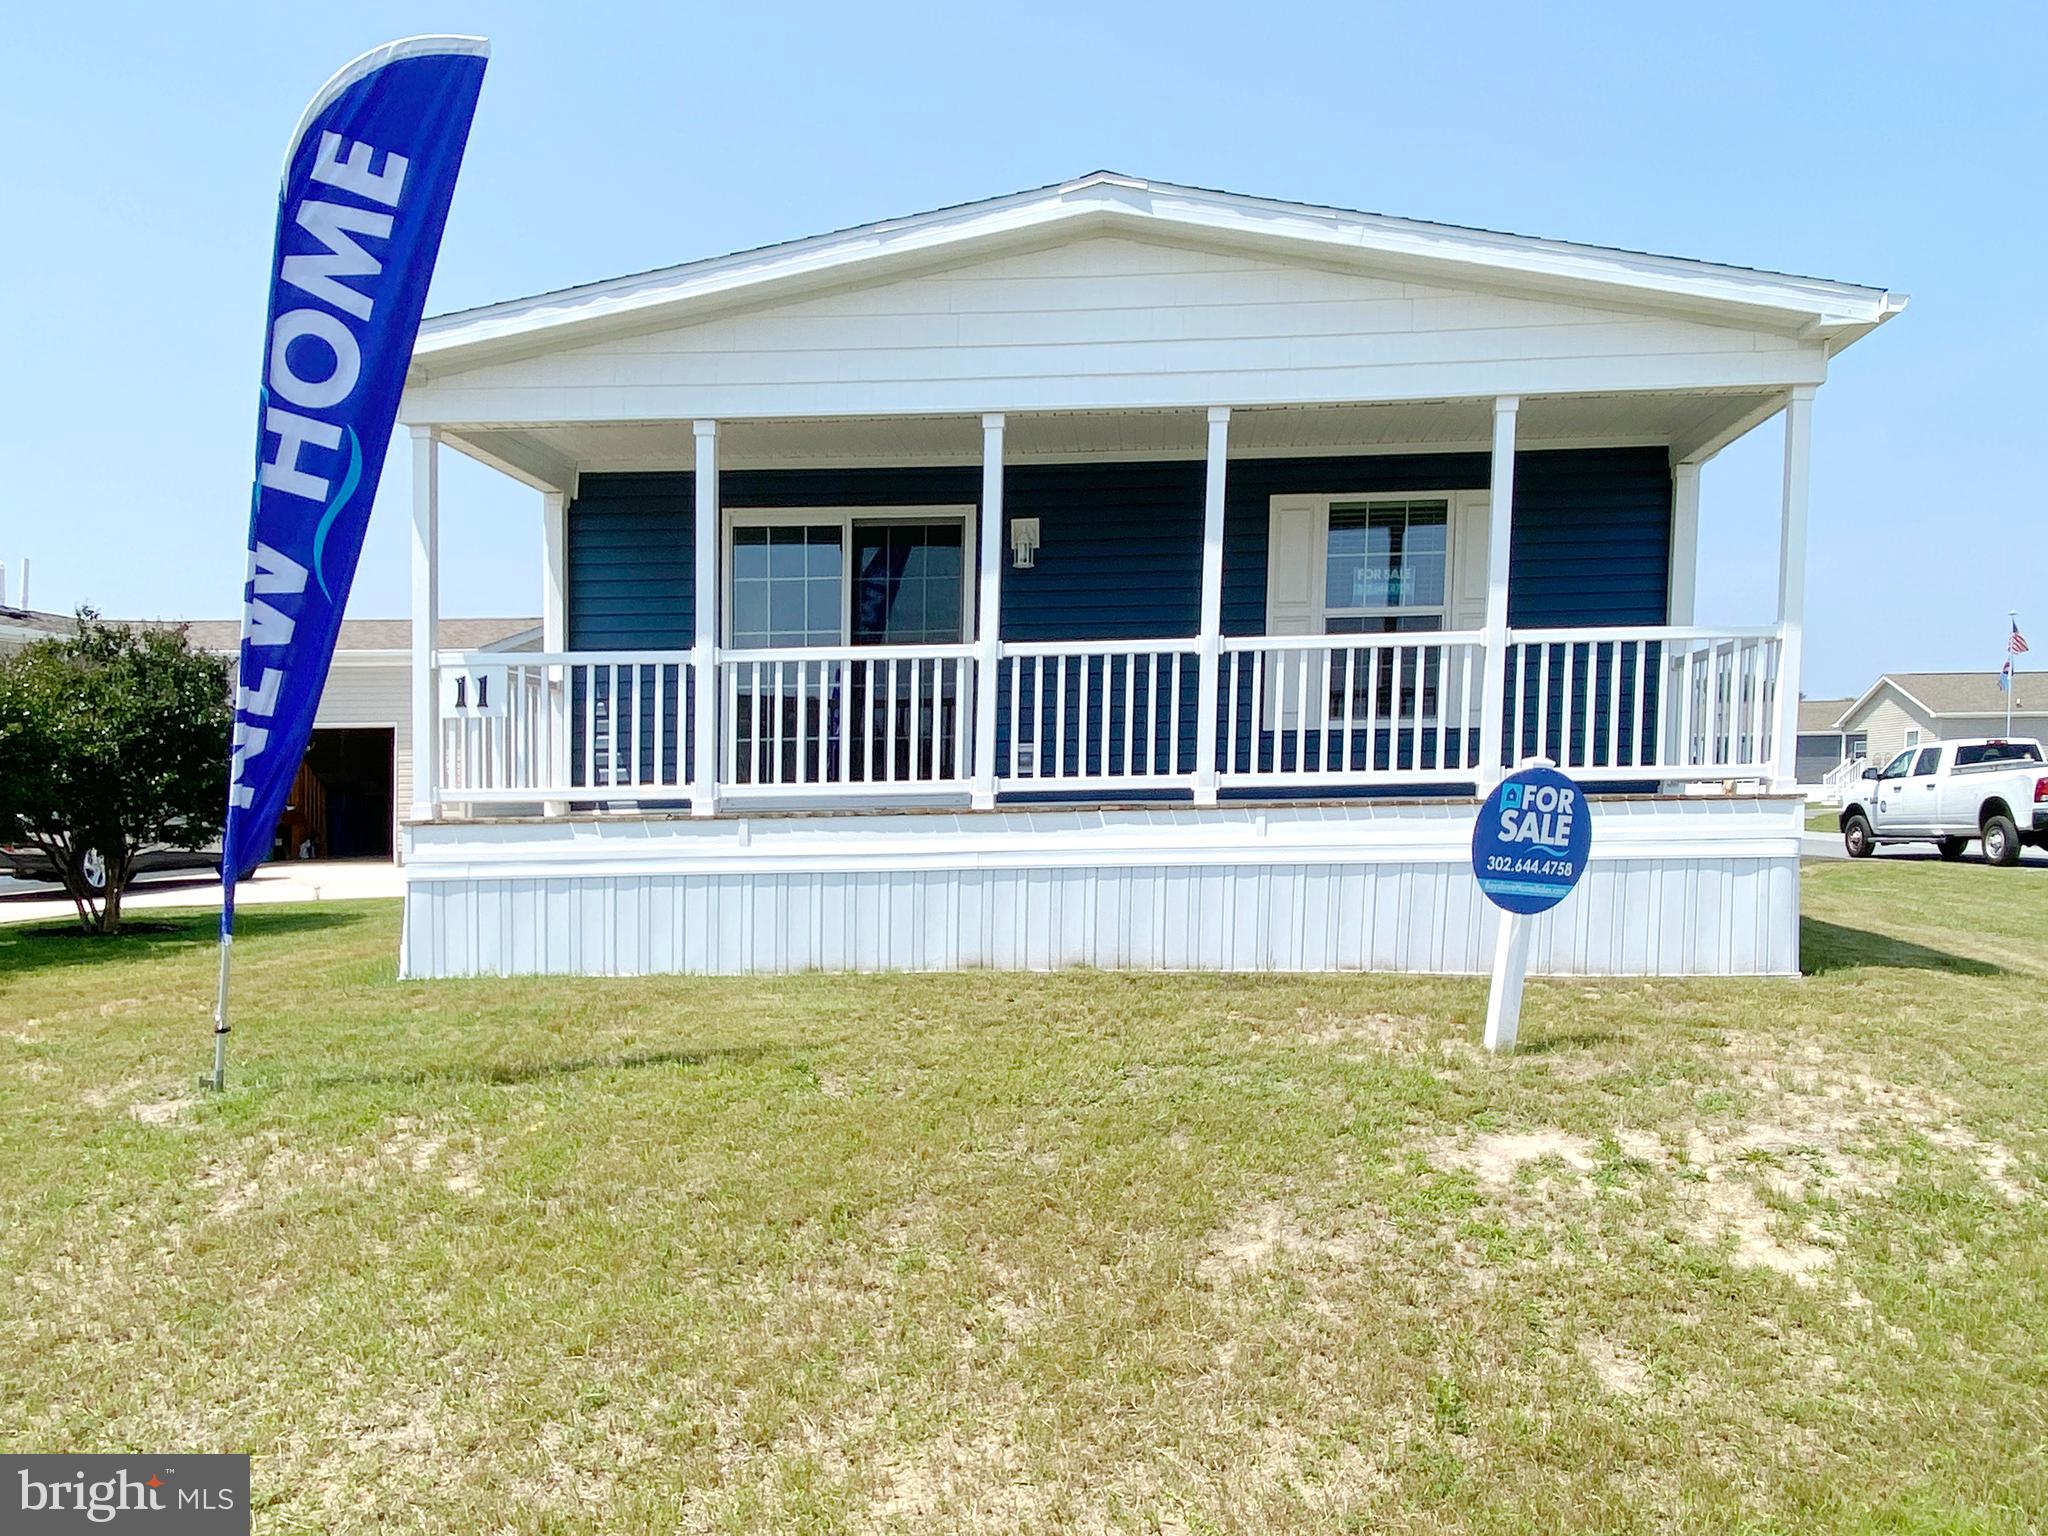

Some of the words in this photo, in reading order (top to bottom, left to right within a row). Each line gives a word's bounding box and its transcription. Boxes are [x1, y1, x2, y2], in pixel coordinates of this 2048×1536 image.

[261, 129, 409, 502] HOME
[1357, 568, 1382, 580] FOR
[1384, 567, 1411, 580] SALE
[455, 674, 488, 708] 11
[1521, 784, 1575, 815] FOR
[1497, 809, 1573, 846] SALE
[1487, 855, 1573, 877] 302.644.4758
